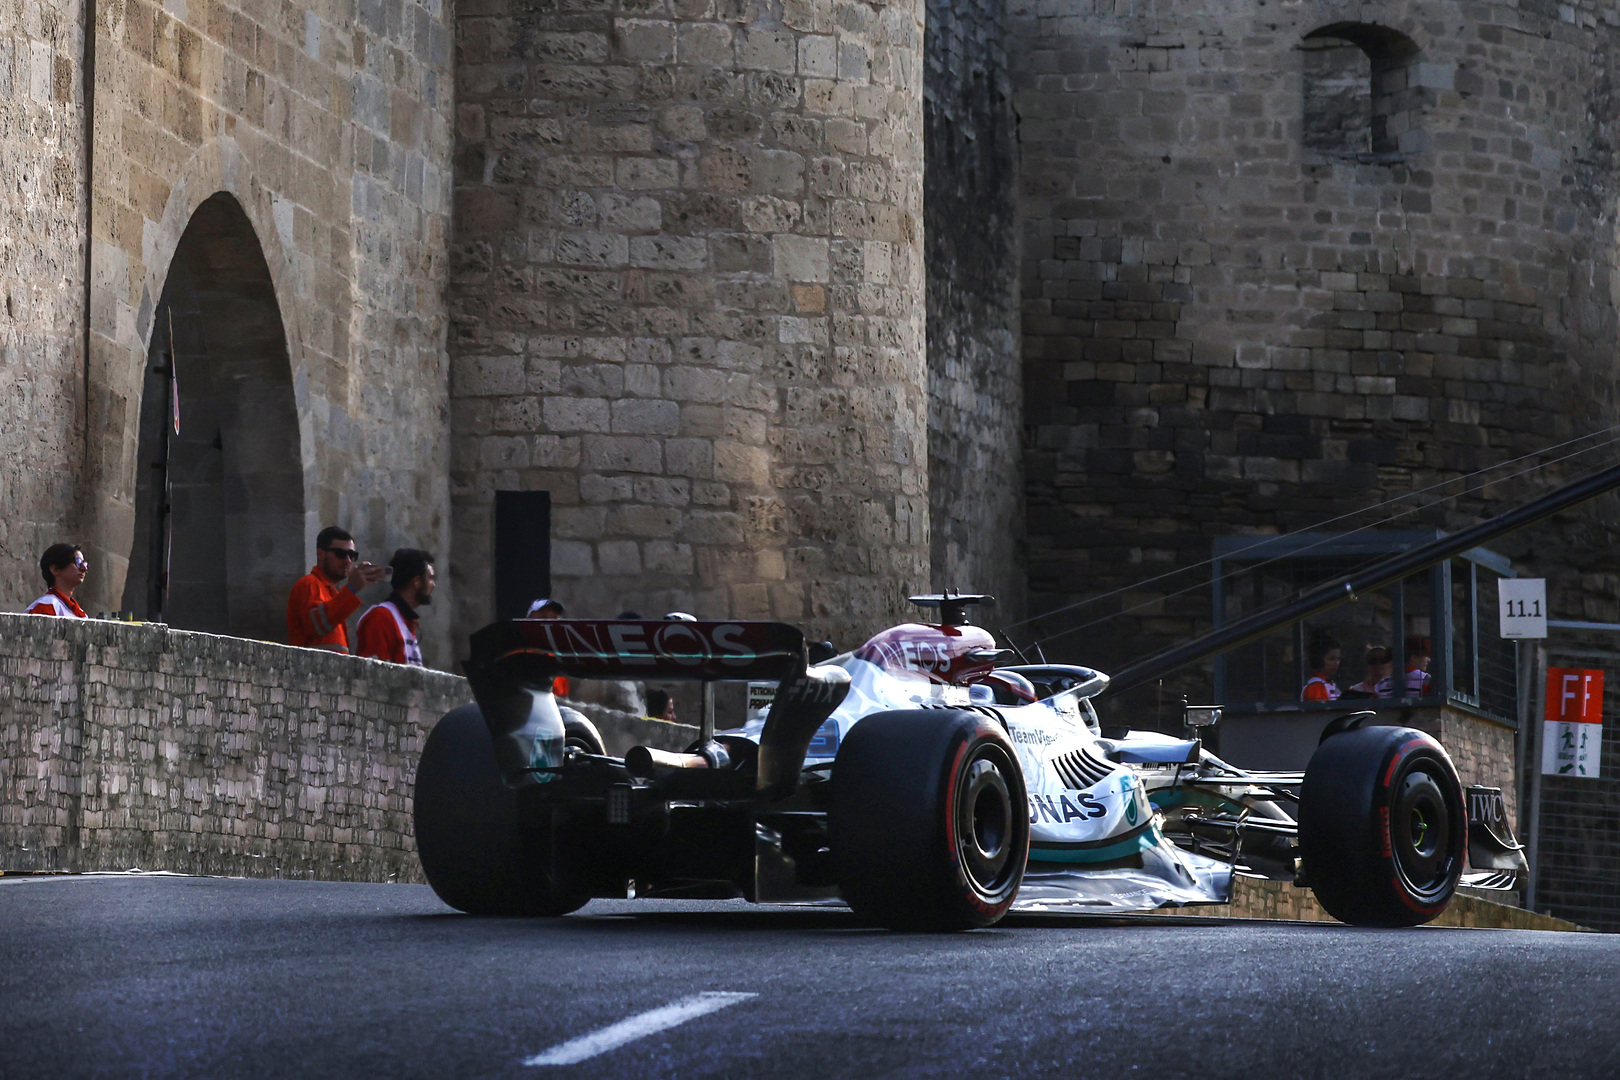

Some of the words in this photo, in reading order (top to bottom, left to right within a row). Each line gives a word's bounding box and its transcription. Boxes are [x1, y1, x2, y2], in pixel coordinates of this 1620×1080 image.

[1506, 600, 1542, 617] 11.1
[540, 624, 756, 666] INEOS
[872, 641, 951, 672] INEOS
[750, 686, 778, 696] PETRONA
[1470, 793, 1502, 822] IWC
